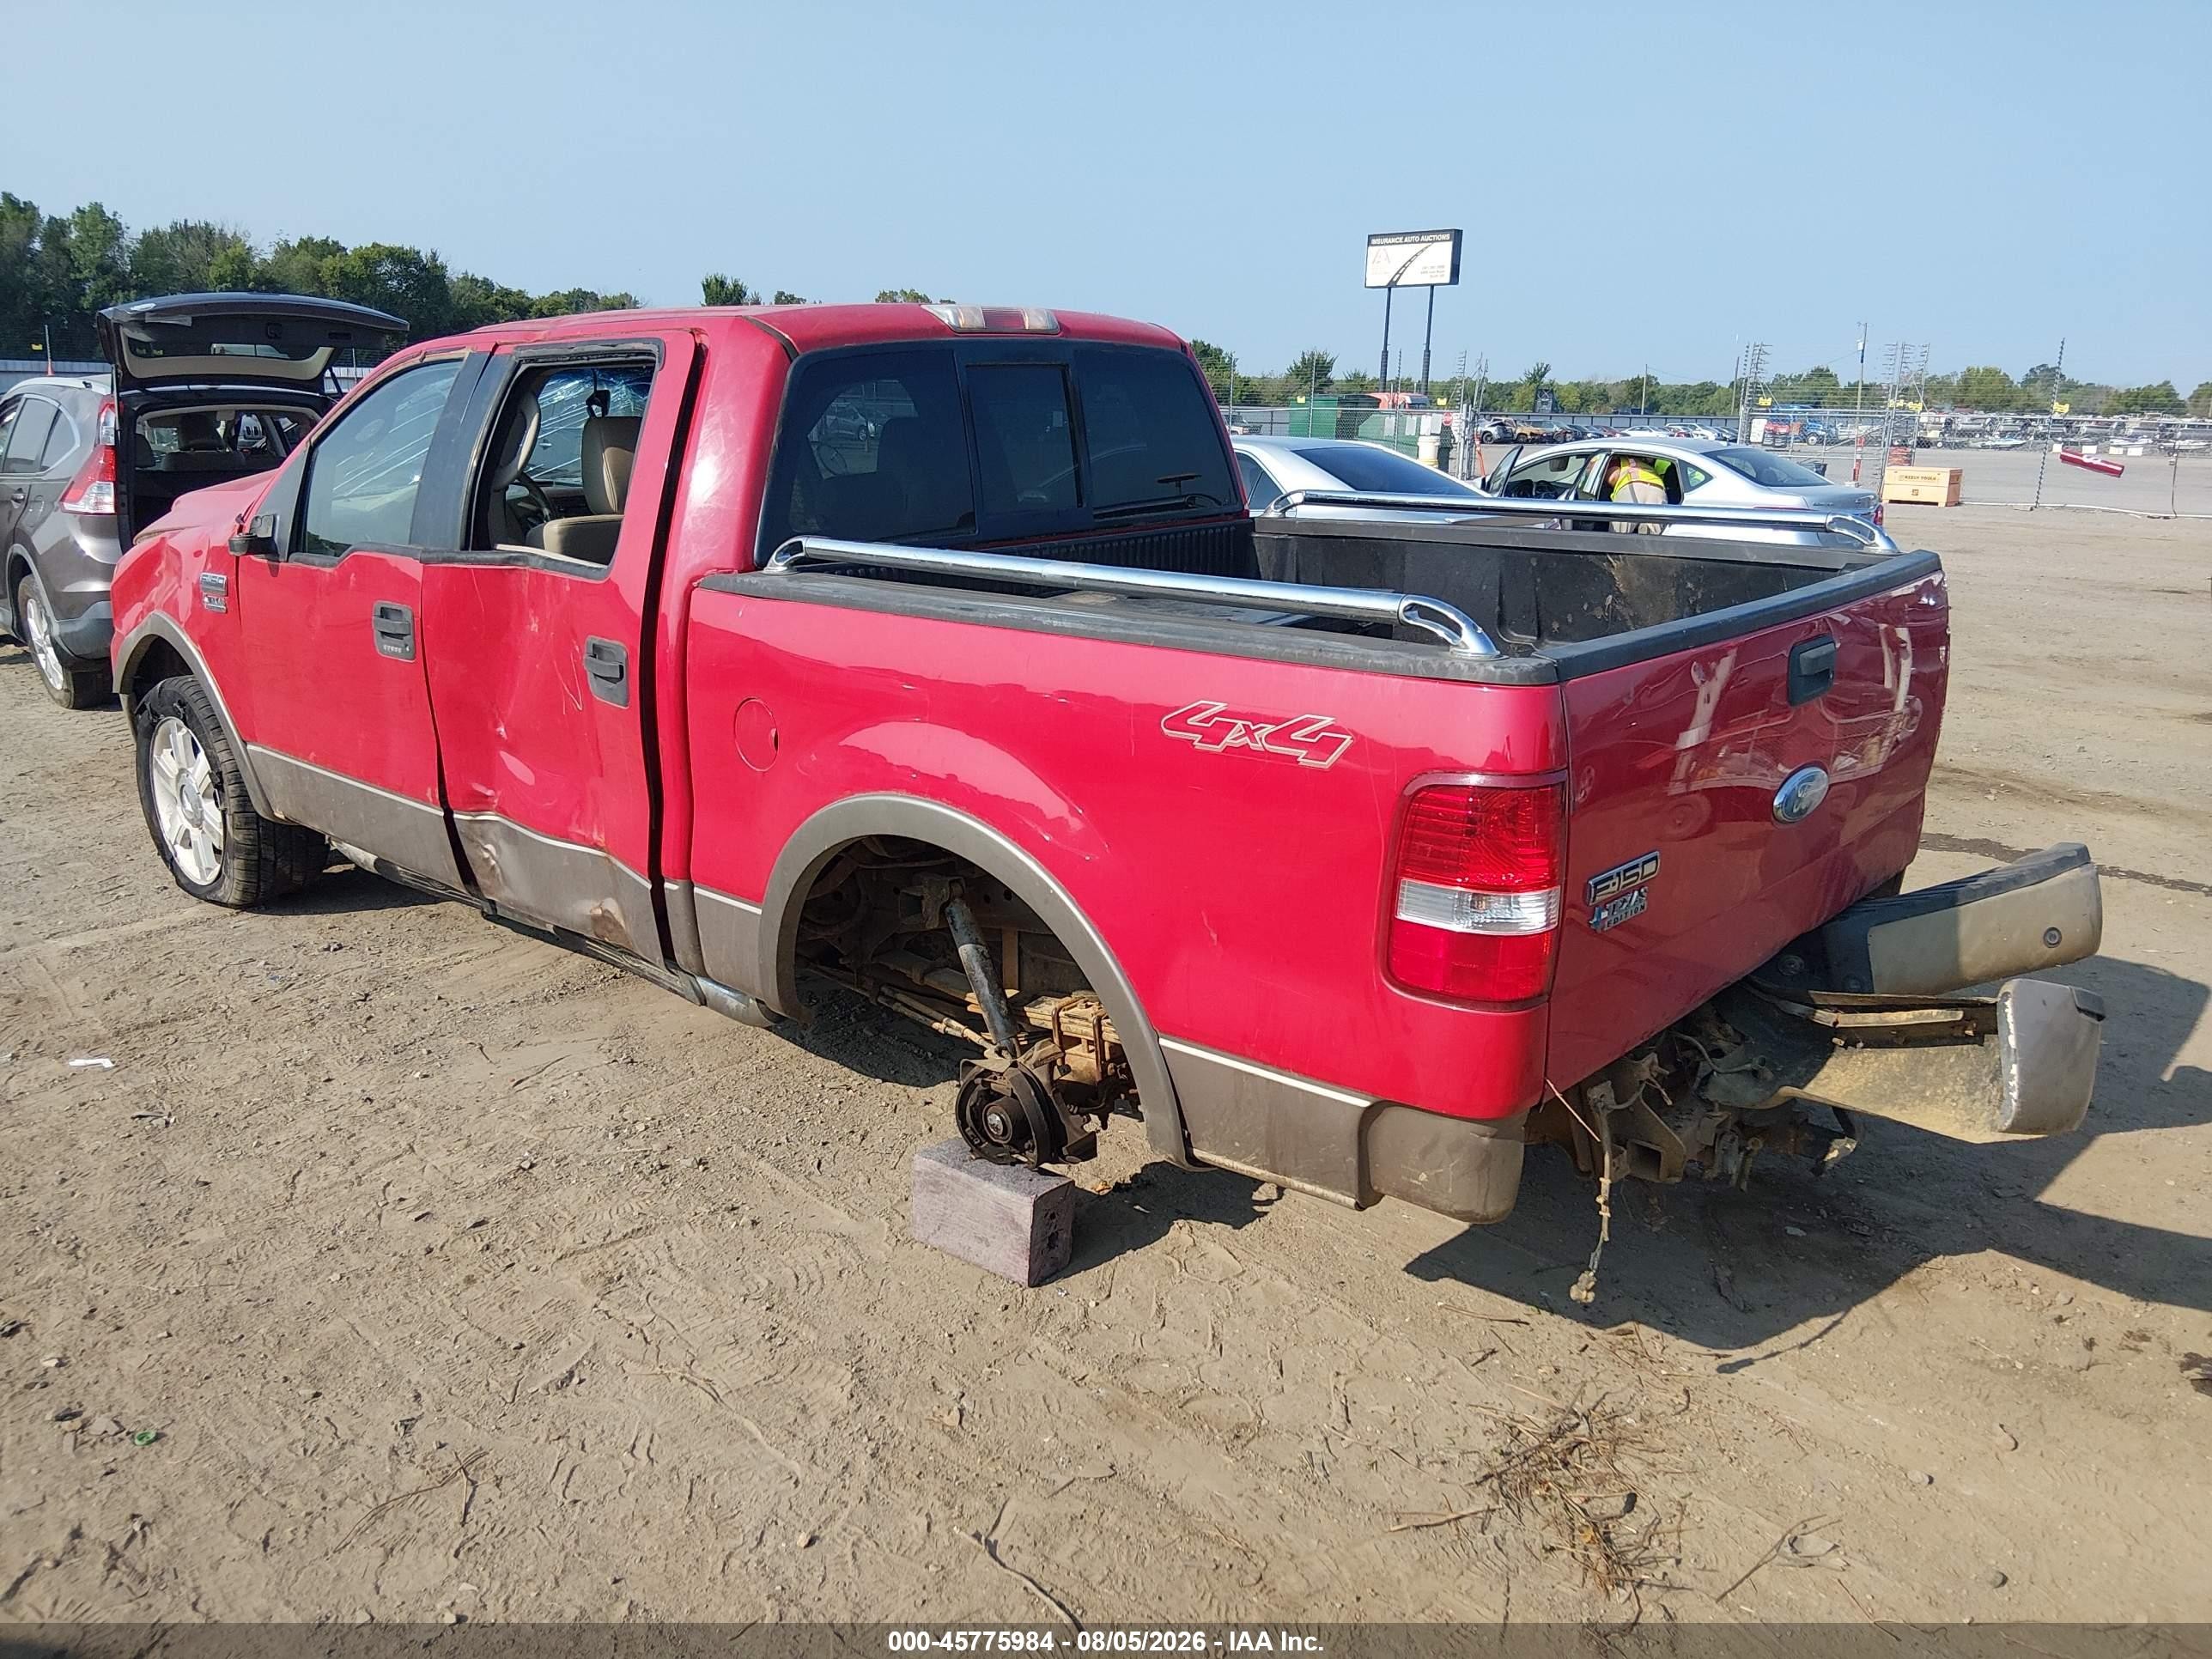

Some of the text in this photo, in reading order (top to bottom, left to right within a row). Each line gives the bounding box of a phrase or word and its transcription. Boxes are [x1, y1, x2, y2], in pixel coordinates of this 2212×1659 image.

[1370, 233, 1451, 246] INSURANCE AUTO AUCTIONS
[1159, 699, 1355, 769] 4x4
[1606, 902, 1647, 929] EDITION
